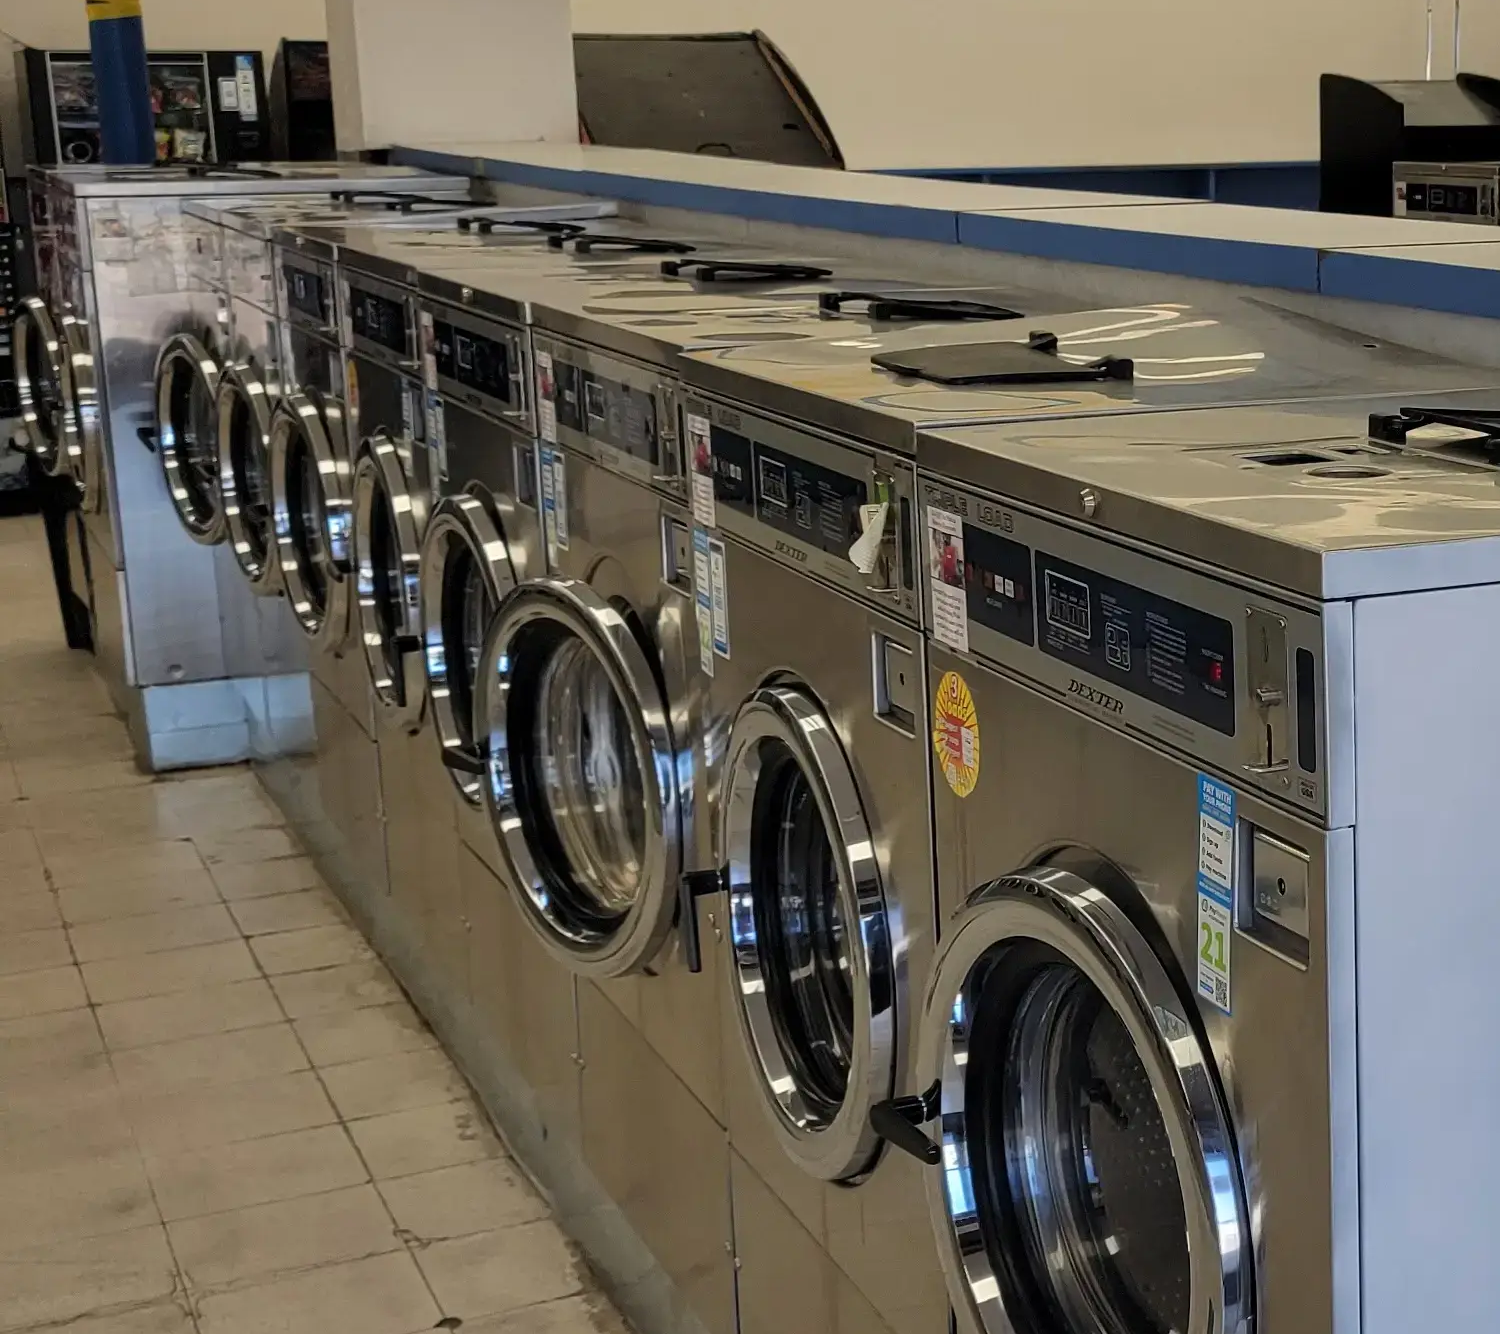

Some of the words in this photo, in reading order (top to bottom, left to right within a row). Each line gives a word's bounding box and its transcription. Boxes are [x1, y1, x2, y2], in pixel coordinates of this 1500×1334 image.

[976, 503, 1015, 534] LOAD
[775, 539, 808, 563] DEXTER
[950, 673, 959, 699] 3
[1068, 679, 1124, 715] DEXTER
[1202, 780, 1215, 796] PAY
[1215, 787, 1232, 806] WITH
[1202, 791, 1216, 806] YOUR
[1201, 922, 1226, 973] 21
